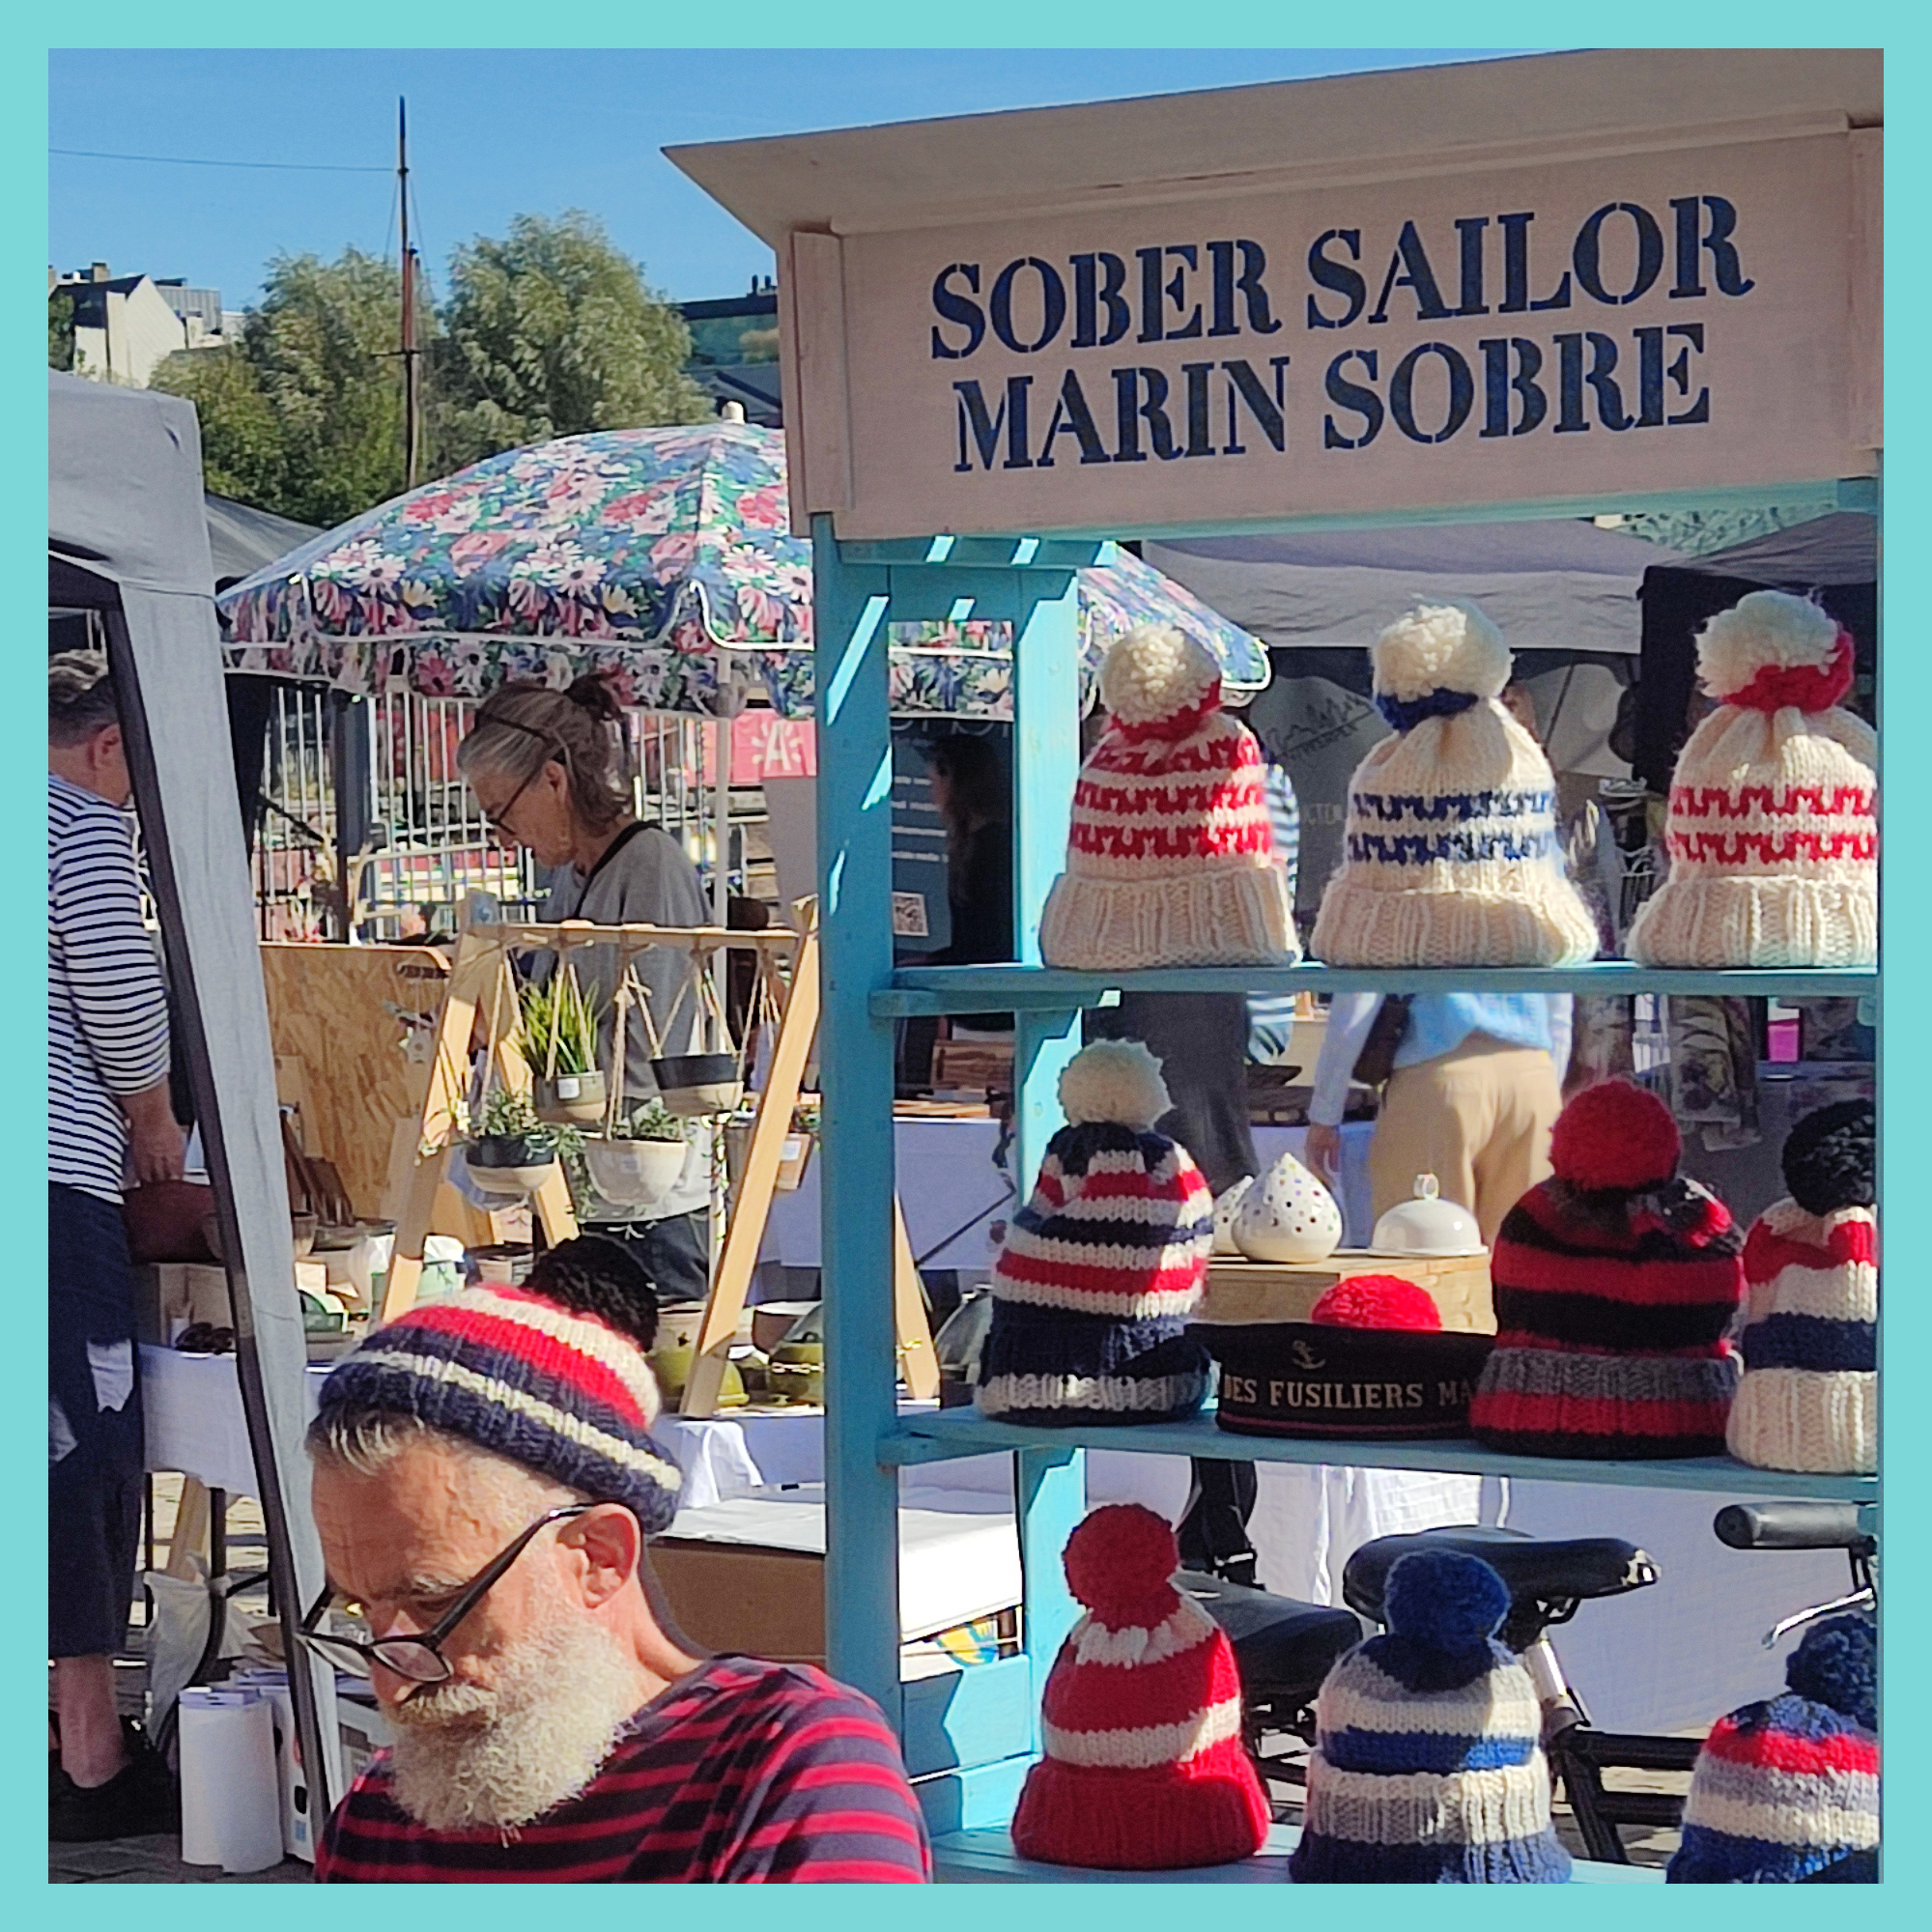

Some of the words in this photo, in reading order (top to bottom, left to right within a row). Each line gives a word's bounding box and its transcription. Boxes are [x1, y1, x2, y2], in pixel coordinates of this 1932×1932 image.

[932, 240, 1282, 358] SOBER
[1308, 196, 1755, 329] SAILOR
[953, 356, 1291, 471] MARIN
[1325, 323, 1710, 449] SOBRE
[1269, 1379, 1424, 1408] FUSILIERS
